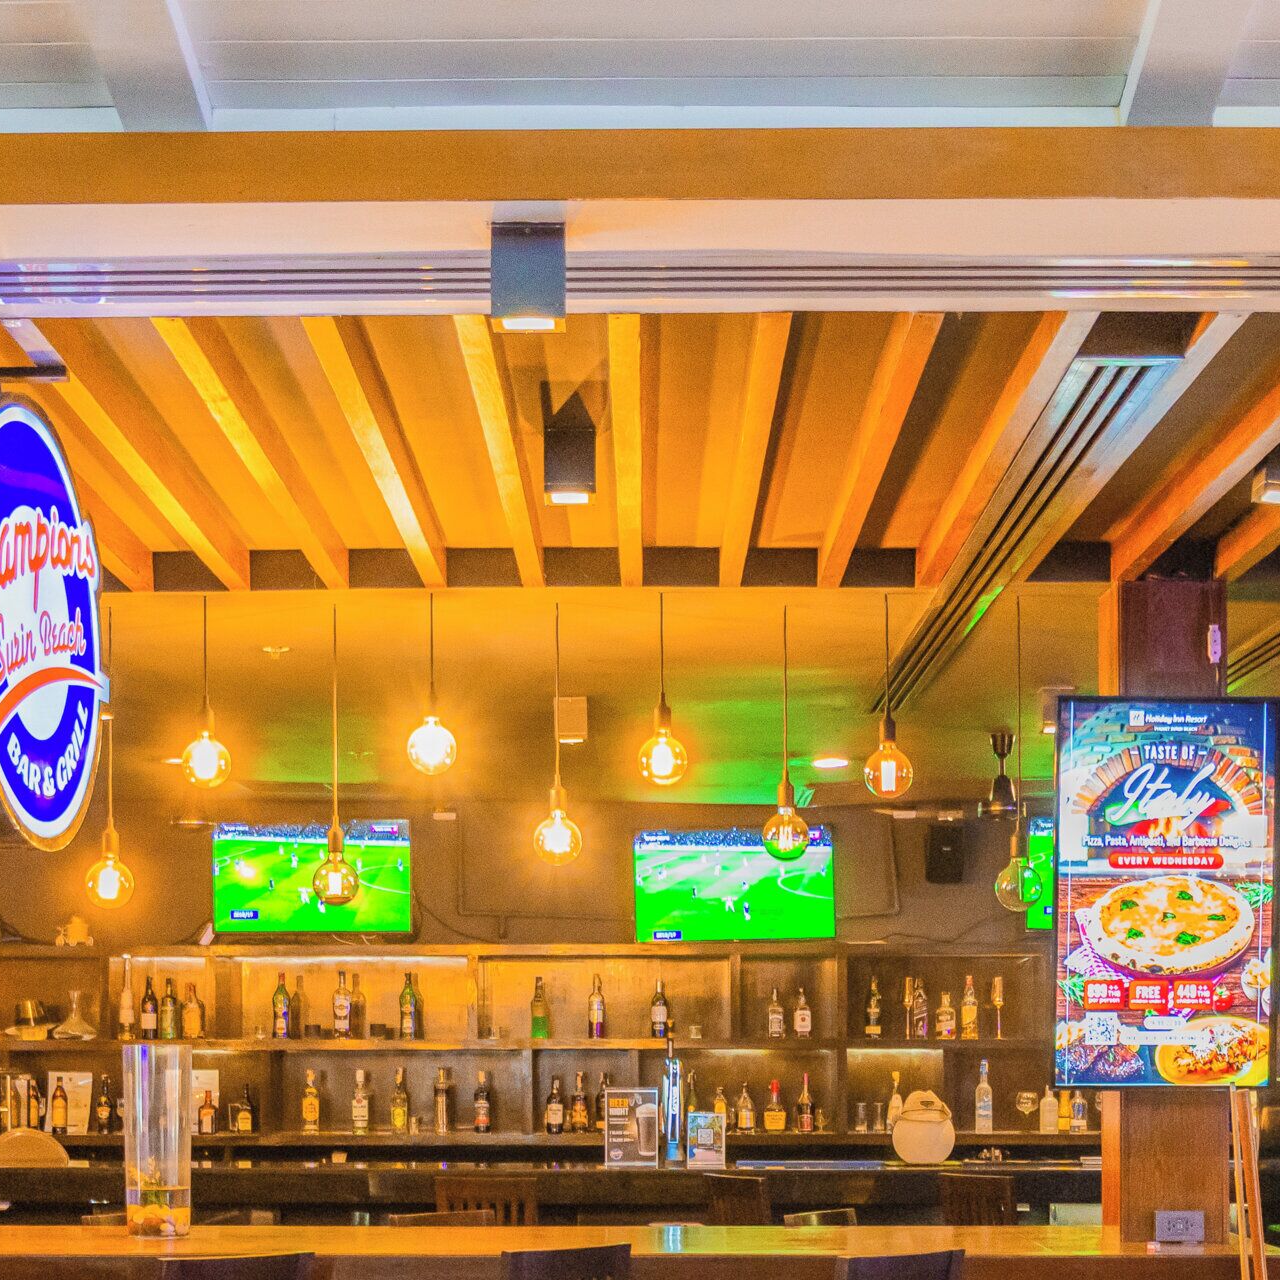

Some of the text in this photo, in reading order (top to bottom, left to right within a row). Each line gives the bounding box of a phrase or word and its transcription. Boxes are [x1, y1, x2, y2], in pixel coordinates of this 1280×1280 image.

[40, 607, 87, 657] Beach
[1145, 714, 1208, 724] Holiday Inn Resort
[6, 700, 89, 797] BAR & GRILL
[1144, 745, 1196, 760] TASTE OF
[1110, 763, 1216, 831] Italy
[1082, 835, 1104, 847] Pizza,
[1105, 835, 1128, 847] Pasta,
[1182, 836, 1218, 847] Barbecue
[1117, 857, 1215, 866] EVERY WEDNESDAY
[1135, 986, 1161, 999] FREE
